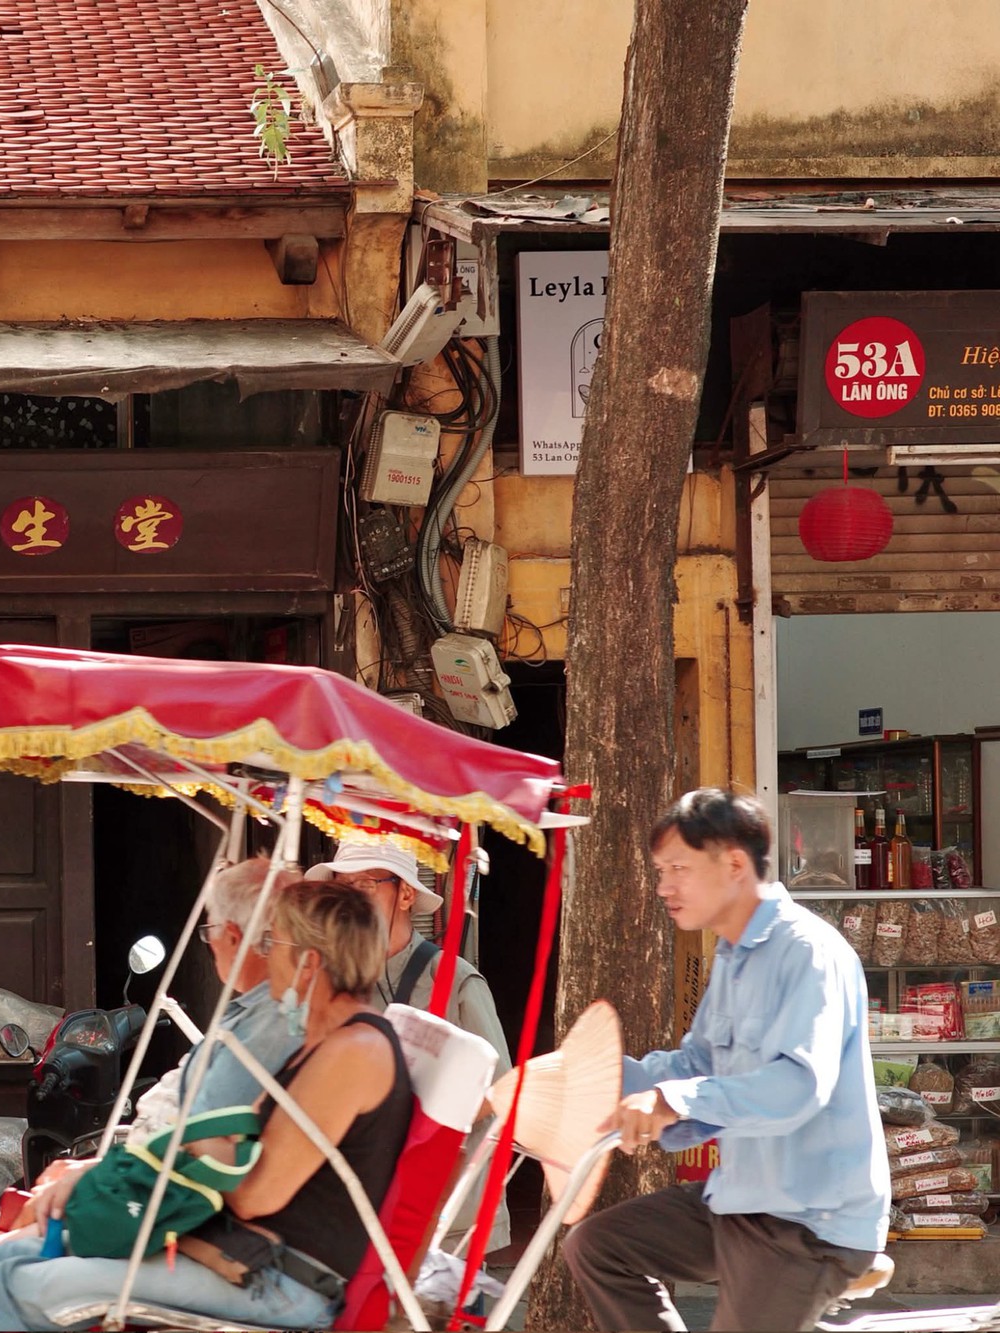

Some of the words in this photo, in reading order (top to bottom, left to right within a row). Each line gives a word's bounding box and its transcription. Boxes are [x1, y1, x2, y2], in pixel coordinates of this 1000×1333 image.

[529, 275, 595, 302] Leyla
[834, 340, 920, 379] 53A
[960, 346, 1000, 368] Hiệ
[842, 381, 872, 401] LÃN
[876, 380, 908, 400] ÔNG
[929, 385, 950, 399] Chủ
[954, 387, 967, 399] cơ
[970, 384, 987, 399] sở:
[928, 405, 946, 417] ĐT:
[949, 404, 977, 417] 0365
[532, 453, 544, 462] 53
[545, 453, 563, 462] Lan
[564, 453, 579, 462] On
[387, 472, 421, 486] 19001515
